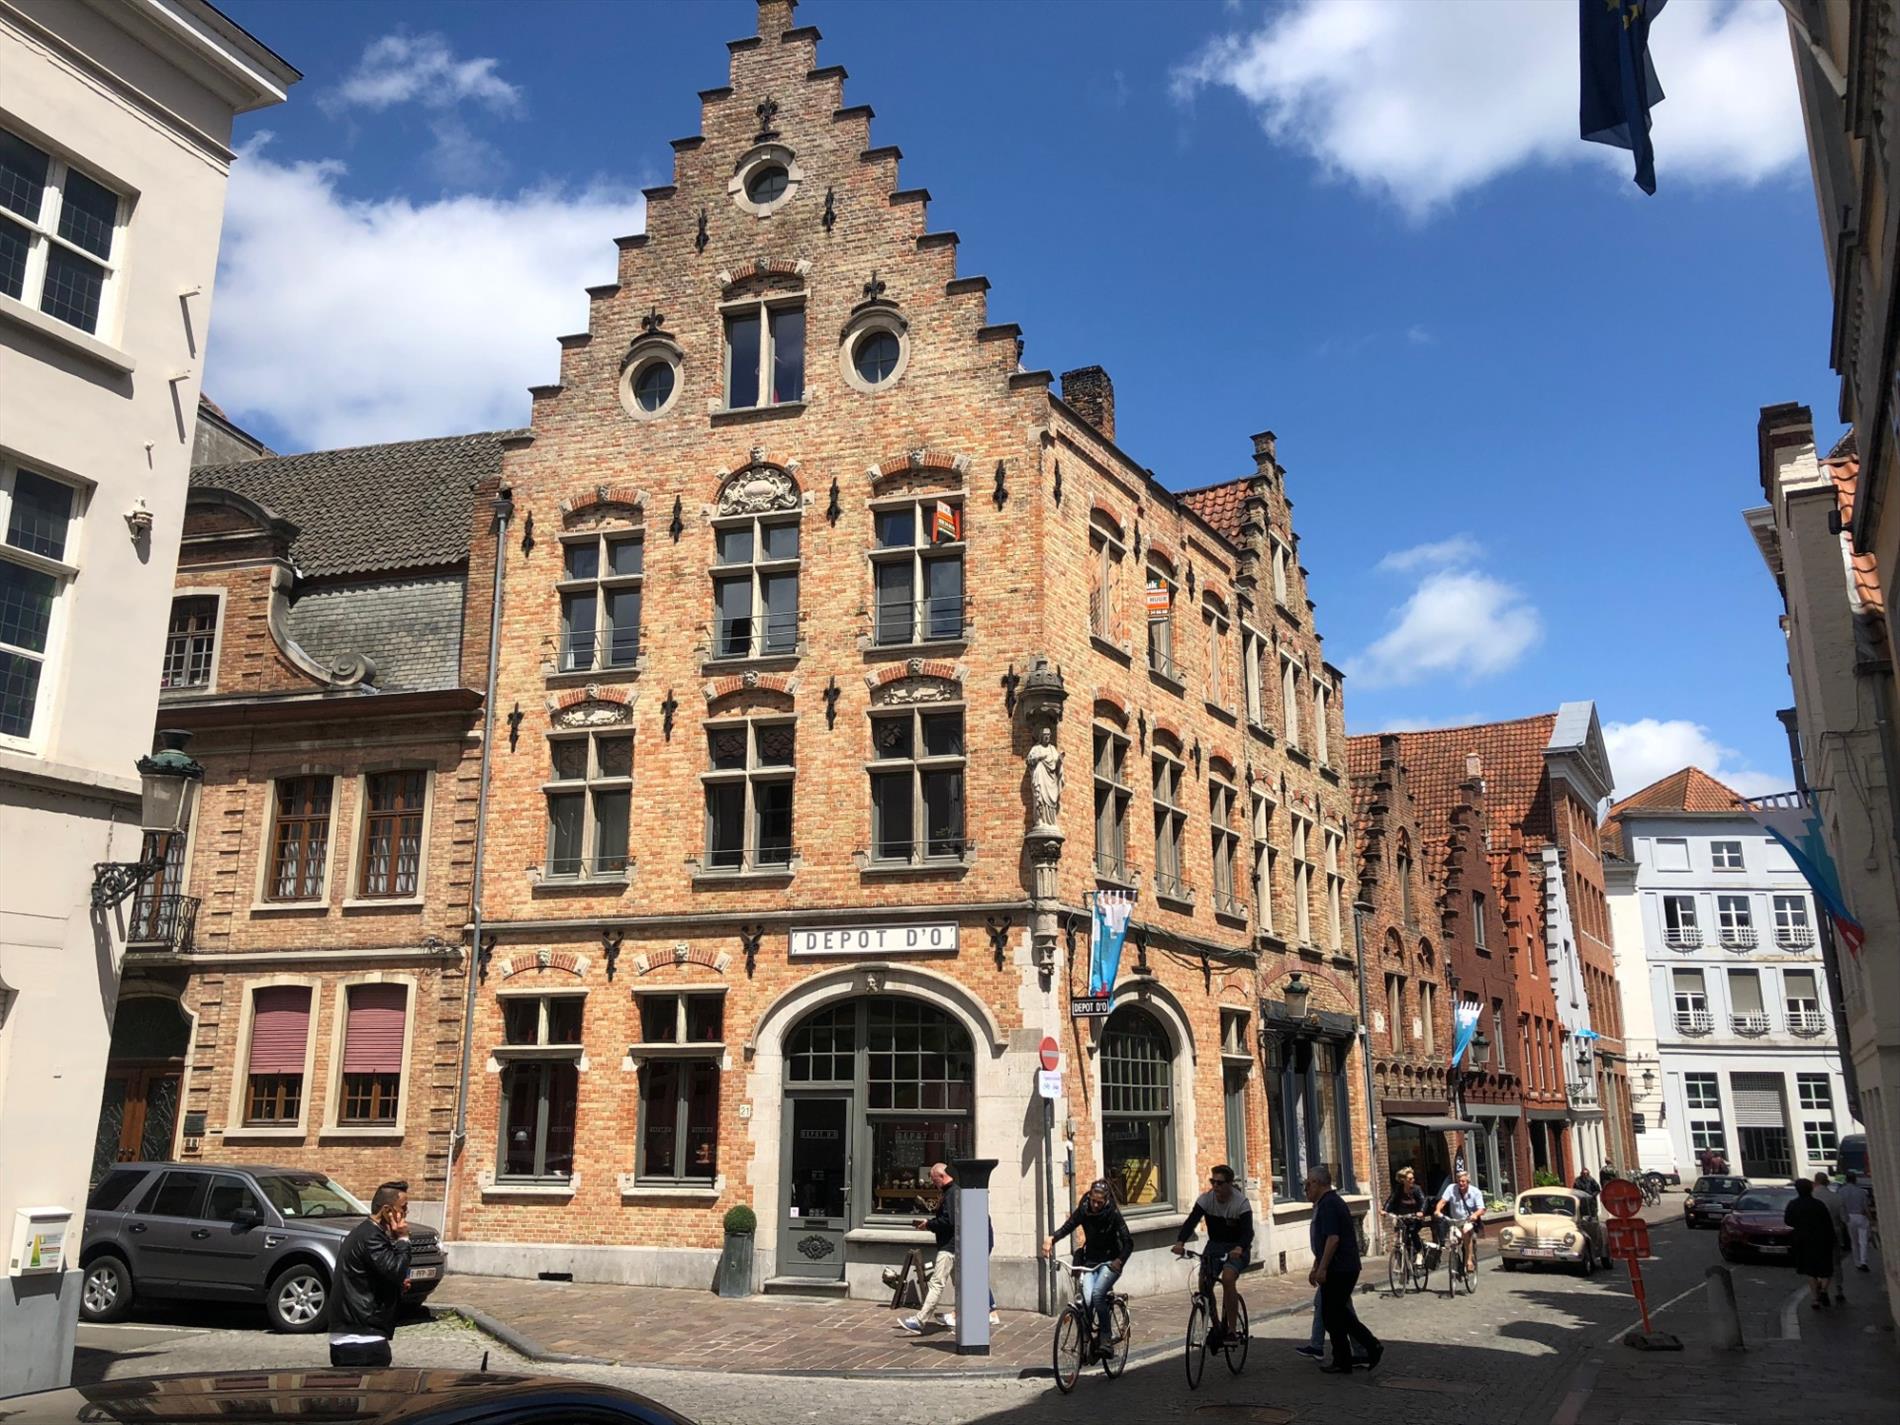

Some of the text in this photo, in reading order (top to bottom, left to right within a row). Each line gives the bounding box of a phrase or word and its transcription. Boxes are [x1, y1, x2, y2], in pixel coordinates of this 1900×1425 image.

[806, 928, 942, 950] DEPOT D'O
[1074, 1001, 1107, 1013] DEPOT D'O
[740, 1106, 750, 1116] 21
